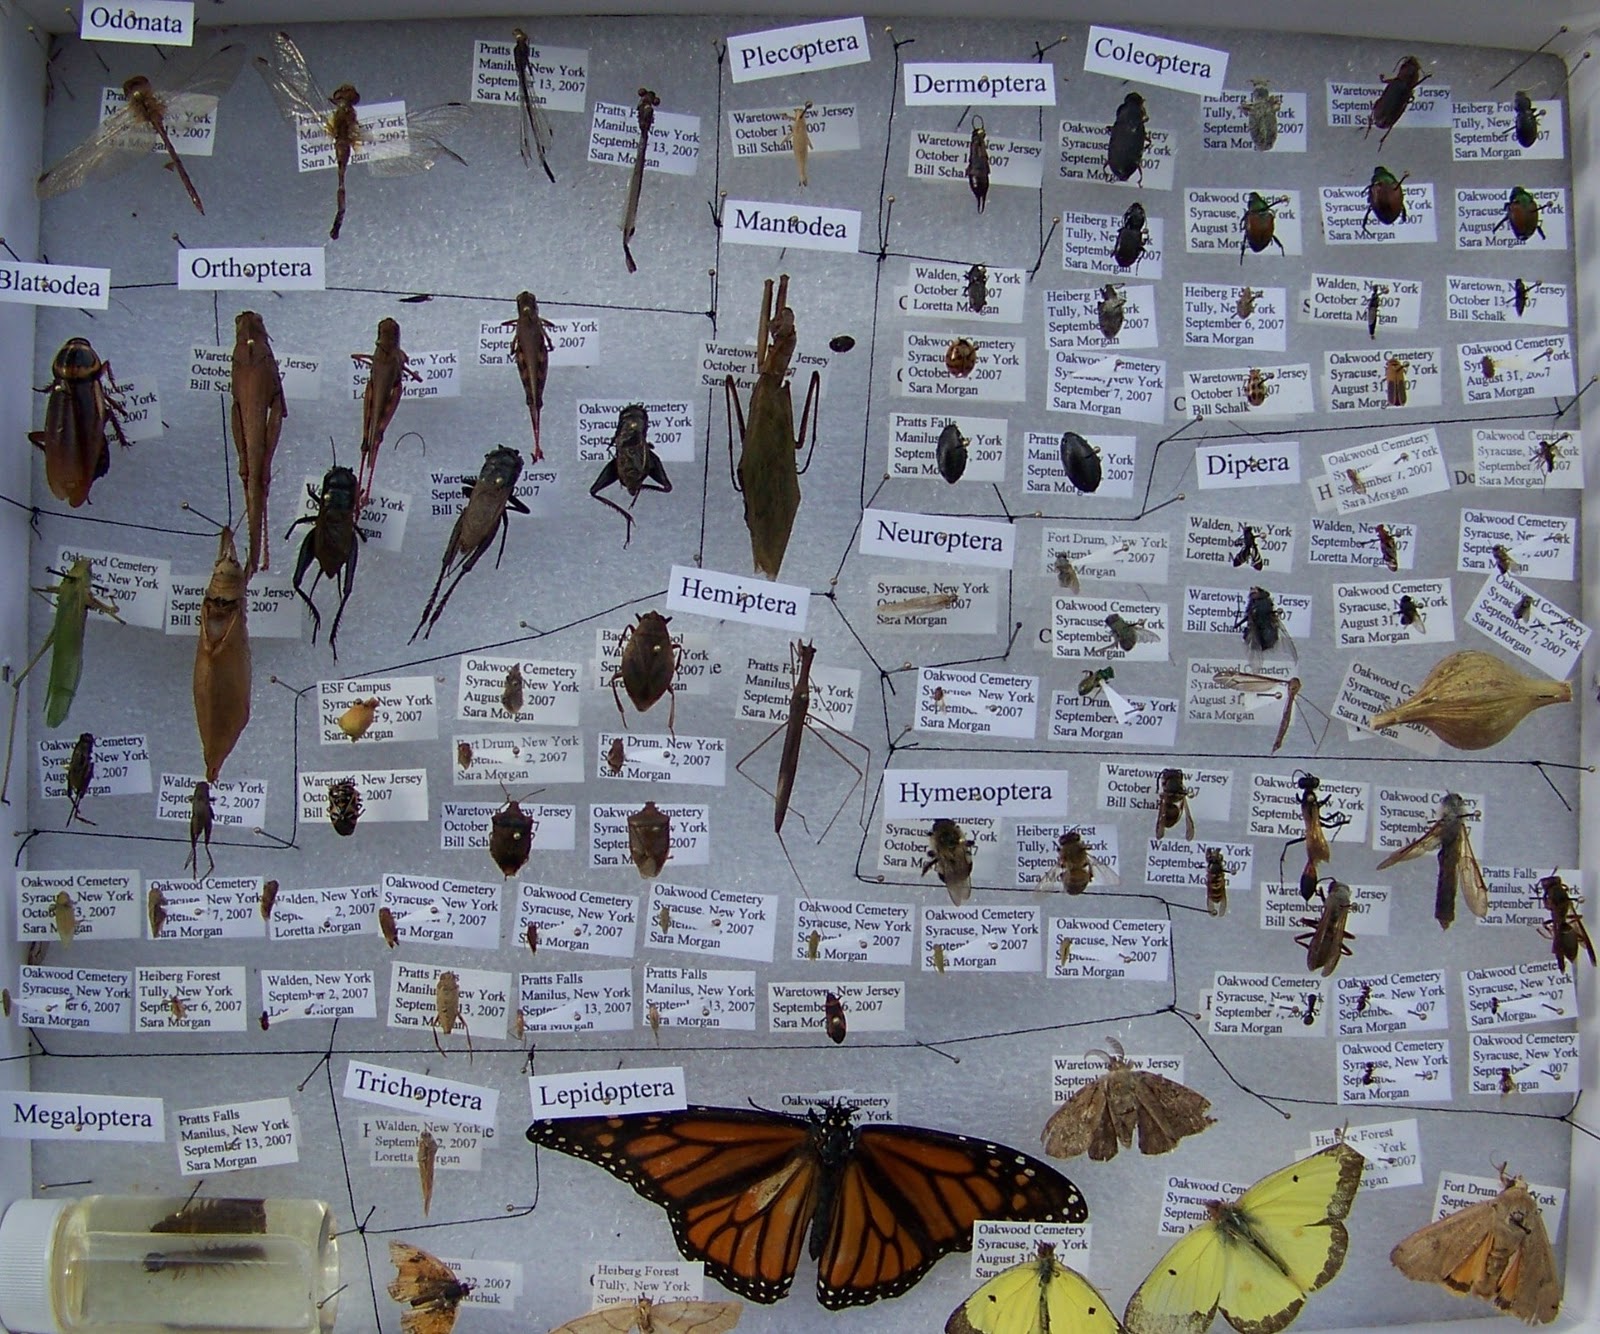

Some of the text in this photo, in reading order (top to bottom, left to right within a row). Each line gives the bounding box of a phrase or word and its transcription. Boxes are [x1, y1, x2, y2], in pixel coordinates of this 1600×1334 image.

[90, 7, 182, 33] Odonata
[480, 43, 511, 56] Pratts
[741, 36, 859, 69] Plecoptera
[1095, 38, 1212, 78] Coleoptera
[561, 66, 585, 77] York
[559, 81, 585, 91] 2007
[914, 74, 1046, 97] Dermoptera
[596, 103, 626, 116] Pratts
[822, 107, 854, 117] Jersey
[1453, 118, 1511, 130] Tully, New
[675, 130, 699, 142] York
[736, 127, 777, 138] October
[590, 149, 613, 160] Sara
[674, 145, 699, 157] 2007
[1008, 144, 1042, 157] Jersey
[1455, 147, 1521, 159] Sara Morgan
[1190, 192, 1239, 203] Oakwood
[735, 210, 847, 238] Mantodea
[1066, 214, 1107, 227] Heiberg
[1066, 229, 1097, 241] Tully,
[1191, 223, 1226, 235] August
[1329, 229, 1395, 241] Sara Morgan
[191, 257, 312, 283] Orthoptera
[915, 268, 959, 281] Walden,
[0, 270, 100, 296] Blattodea
[995, 273, 1020, 284] York
[1317, 278, 1360, 291] Walden,
[1393, 283, 1419, 294] York
[1048, 305, 1080, 318] Tully,
[1450, 309, 1506, 321] Bill Schalk
[481, 324, 503, 334] Fort
[572, 321, 598, 333] York
[1186, 317, 1284, 330] September 6, 2007
[560, 337, 585, 348] 2007
[1186, 332, 1254, 345] Sara Morgan
[1462, 337, 1564, 356] Oakwood Cemetery
[430, 353, 456, 365] York
[1330, 350, 1433, 364] Oakwood Cemetery
[428, 368, 453, 380] 2007
[908, 383, 978, 397] Sara Morgan
[1469, 385, 1534, 400] Sara Morgan
[1054, 398, 1121, 415] Sara Morgan
[666, 417, 692, 428] York
[896, 416, 927, 428] Pratts
[977, 435, 1002, 446] York
[1329, 433, 1429, 465] Oakwood Cemetery
[1208, 454, 1290, 478] Diptera
[524, 471, 557, 483] Jersey
[1342, 486, 1408, 509] Sara Morgan
[1191, 517, 1235, 532] Walden,
[1465, 512, 1567, 530] Oakwood Cemetery
[877, 520, 1003, 552] Neuroptera
[1048, 532, 1108, 546] Fort Drum,
[110, 559, 158, 575] Cemetery
[878, 583, 929, 596] Syracuse,
[965, 583, 989, 594] York
[1338, 583, 1442, 597] Oakwood Cemetery
[681, 577, 797, 616] Hemiptera
[1056, 600, 1160, 616] Oakwood Cemetery
[1479, 598, 1567, 658] September 7, 2007
[1341, 630, 1409, 644] Sara Morgan
[523, 663, 577, 678] Cemetery
[523, 678, 579, 692] New York
[924, 670, 1032, 688] Oakwood Cemetery
[321, 682, 391, 695] ESF Campus
[528, 695, 555, 706] 2007
[920, 717, 990, 733] Sara Morgan
[522, 735, 579, 748] New York
[667, 738, 723, 751] New York
[95, 750, 148, 762] New York
[541, 752, 567, 762] 2007
[362, 773, 422, 786] New Jersey
[211, 780, 264, 793] New York
[367, 790, 392, 800] 2007
[900, 782, 1052, 807] Hymenoptera
[219, 795, 259, 808] 2, 2007
[22, 876, 129, 889] Oakwood Cemetery
[78, 891, 133, 902] New York
[523, 886, 632, 908] Oakwood Cemetery
[925, 909, 1034, 923] Oakwood Cemetery
[140, 970, 220, 984] Heiberg Forest
[268, 972, 371, 987] Walden, New York
[521, 973, 583, 986] Pratts Falls
[1217, 975, 1321, 989] Oakwood Cemetery
[522, 987, 630, 1002] Manilus, New York
[140, 1016, 211, 1030] Sara Morgan
[1214, 1021, 1282, 1035] Sara Morgan
[1343, 1040, 1444, 1055] Oakwood Cemetery
[1474, 1047, 1578, 1063] Syracuse, New York
[356, 1069, 482, 1111] Trichoptera
[540, 1080, 675, 1109] Lepidoptera
[1343, 1088, 1409, 1100] Sara Morgan
[14, 1104, 152, 1129] Megaloptera
[179, 1110, 240, 1125] Pratts Falls
[187, 1155, 257, 1171] Sara Morgan
[978, 1224, 1086, 1238] Oakwood Cemetery
[598, 1280, 690, 1293] Tully, New York
